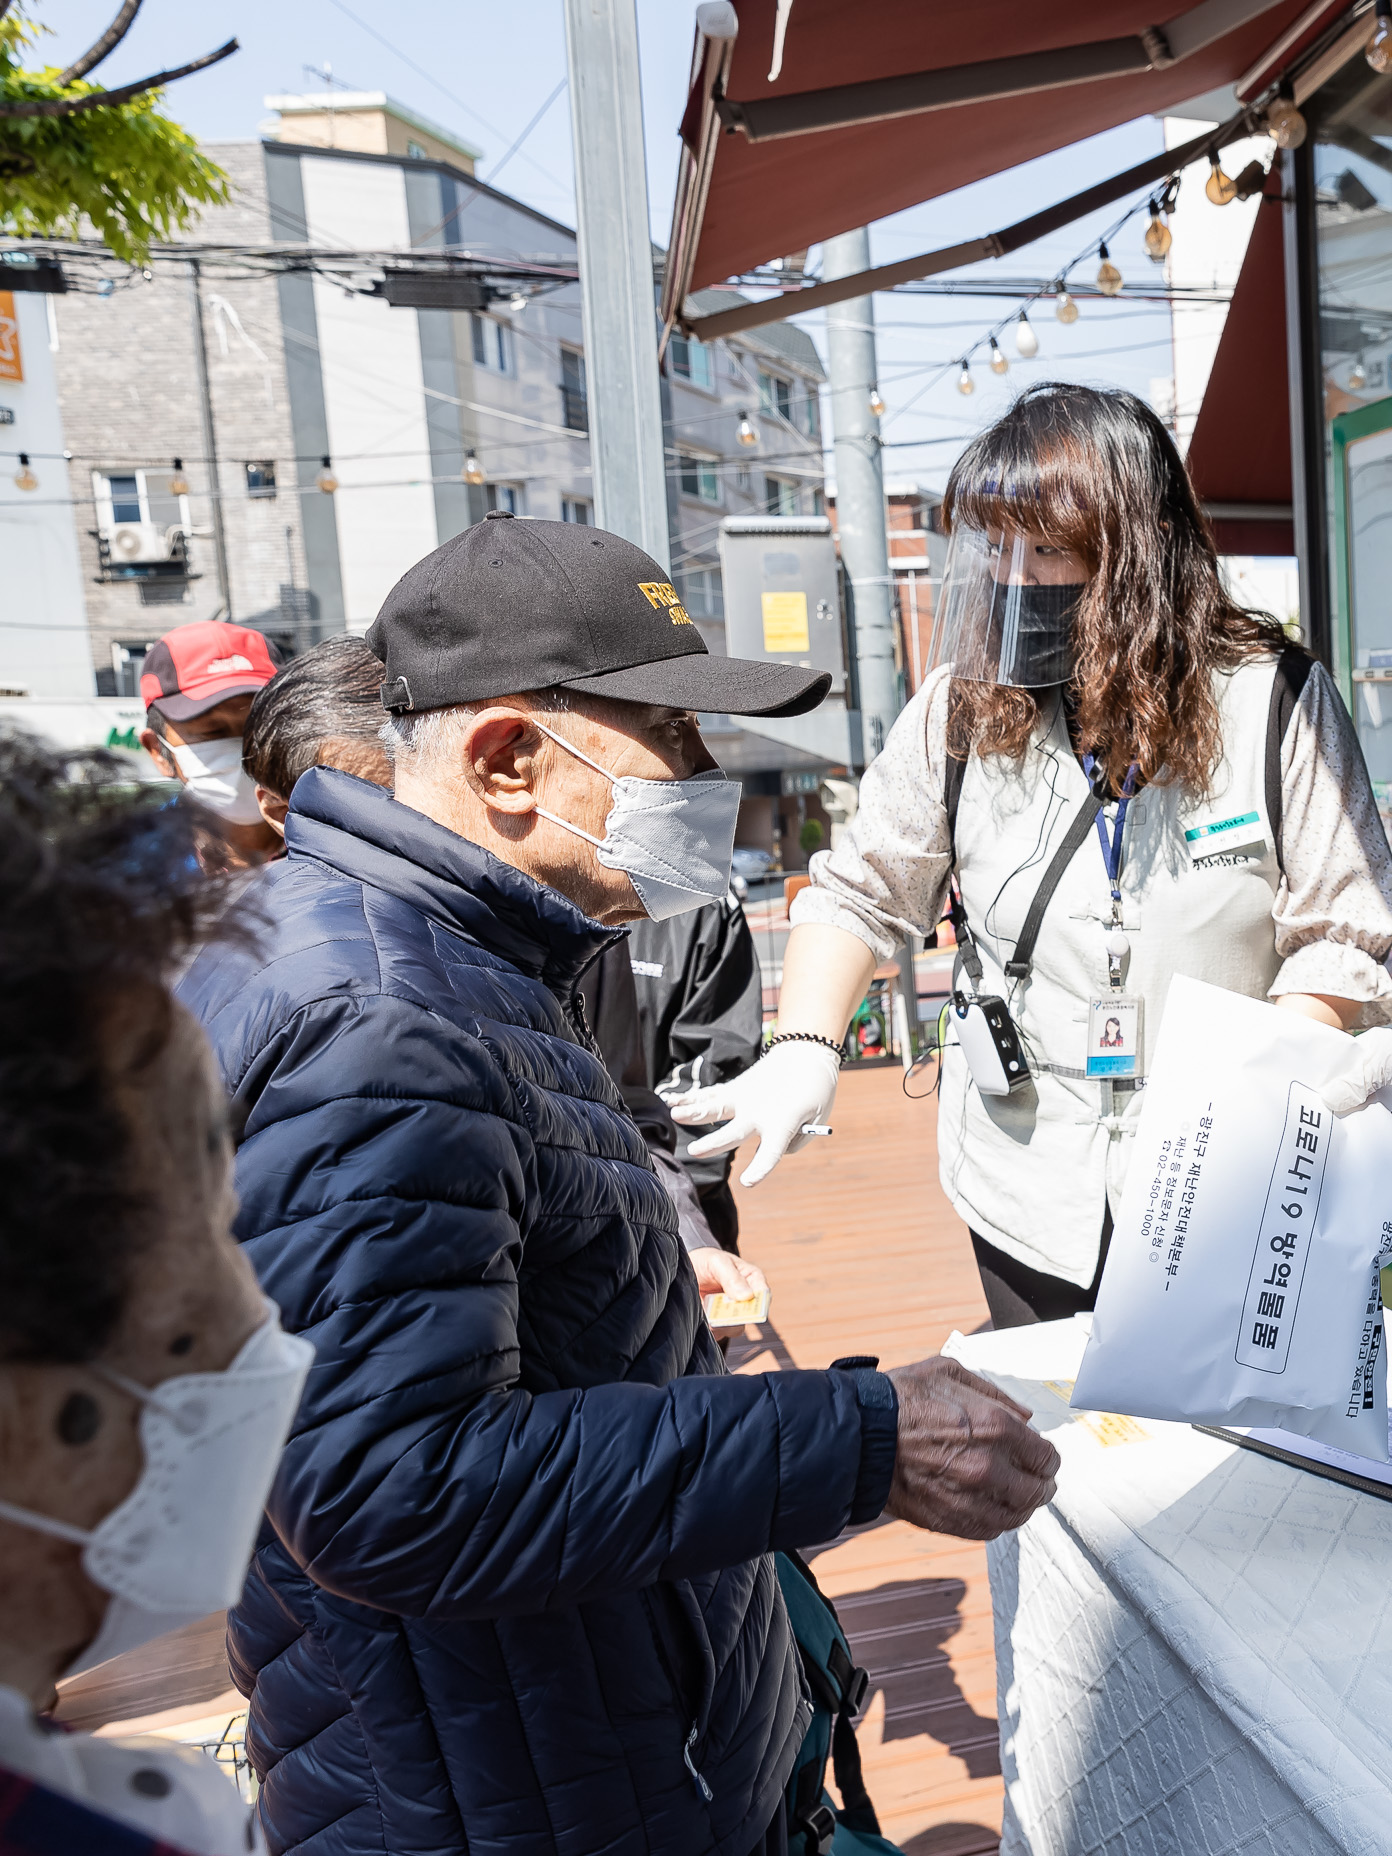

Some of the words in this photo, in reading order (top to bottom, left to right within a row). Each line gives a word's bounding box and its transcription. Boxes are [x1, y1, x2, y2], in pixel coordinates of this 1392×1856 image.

[1173, 1136, 1187, 1158] 재난
[1193, 1116, 1213, 1157] 광진구
[1170, 1162, 1181, 1172] 등
[1281, 1104, 1321, 1219] 코로나19
[1140, 1154, 1168, 1236] 02-450-1000
[1158, 1177, 1178, 1221] 정보문자
[1151, 1225, 1166, 1248] 신청
[1165, 1162, 1201, 1276] 재난안전대책본부
[1252, 1232, 1298, 1350] 방역물품
[1358, 1320, 1373, 1360] 다하고
[1345, 1365, 1364, 1418] 있습니다
